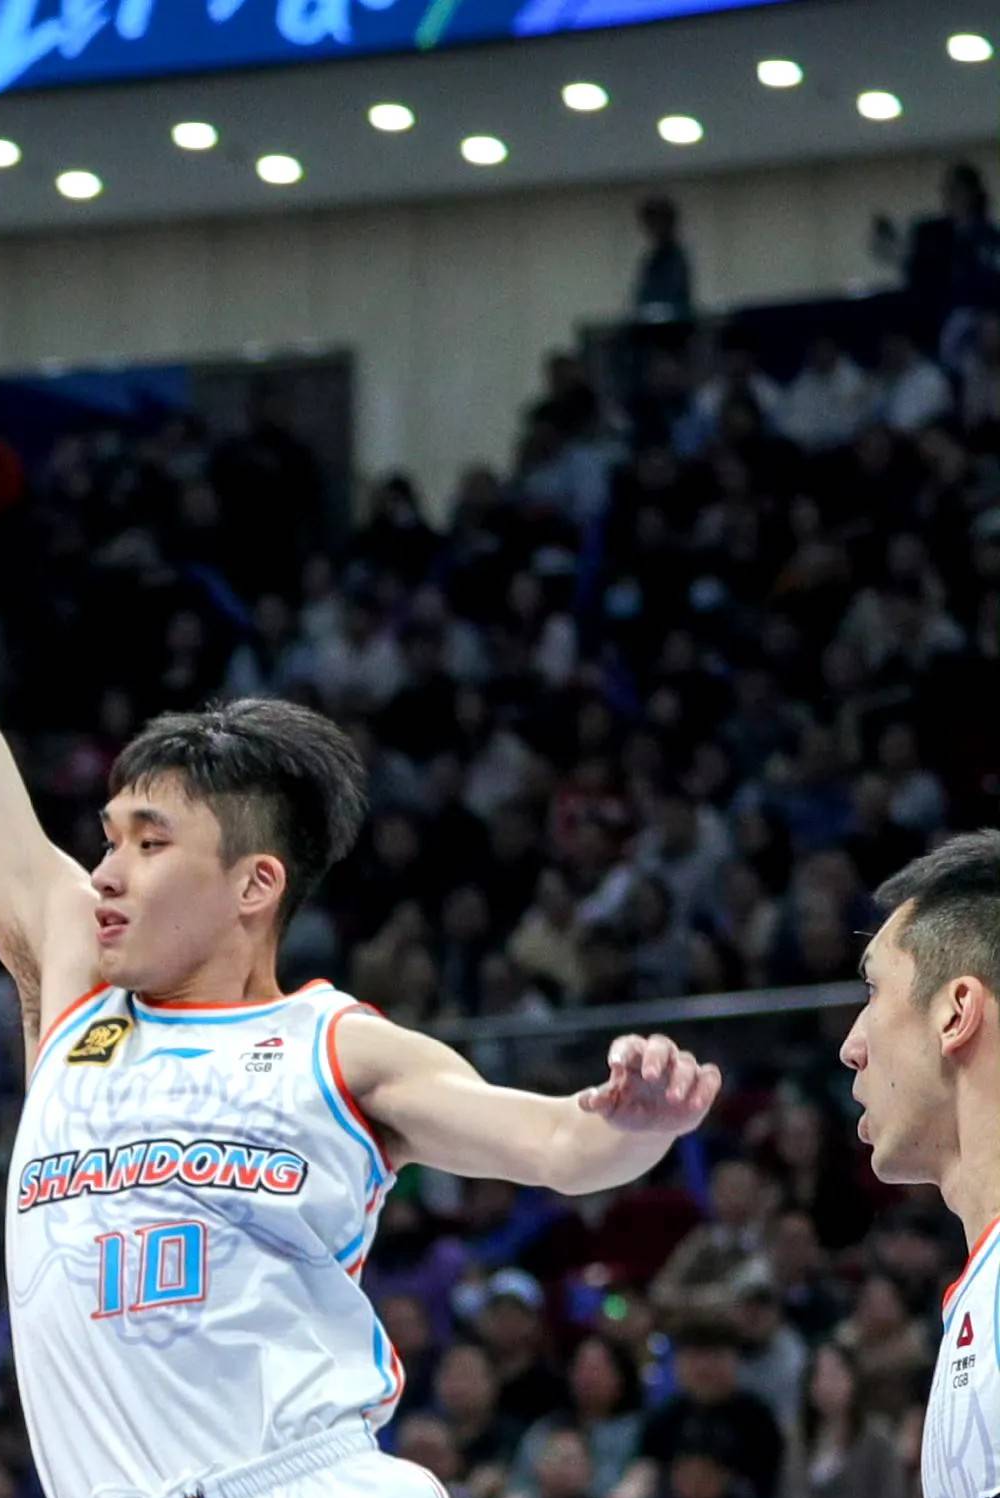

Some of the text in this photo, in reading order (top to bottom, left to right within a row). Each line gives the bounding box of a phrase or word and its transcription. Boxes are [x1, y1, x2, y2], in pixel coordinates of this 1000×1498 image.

[245, 1062, 272, 1073] CGB
[18, 1139, 307, 1213] SHANDONG
[91, 1219, 209, 1319] 10
[953, 1372, 969, 1389] CGB
